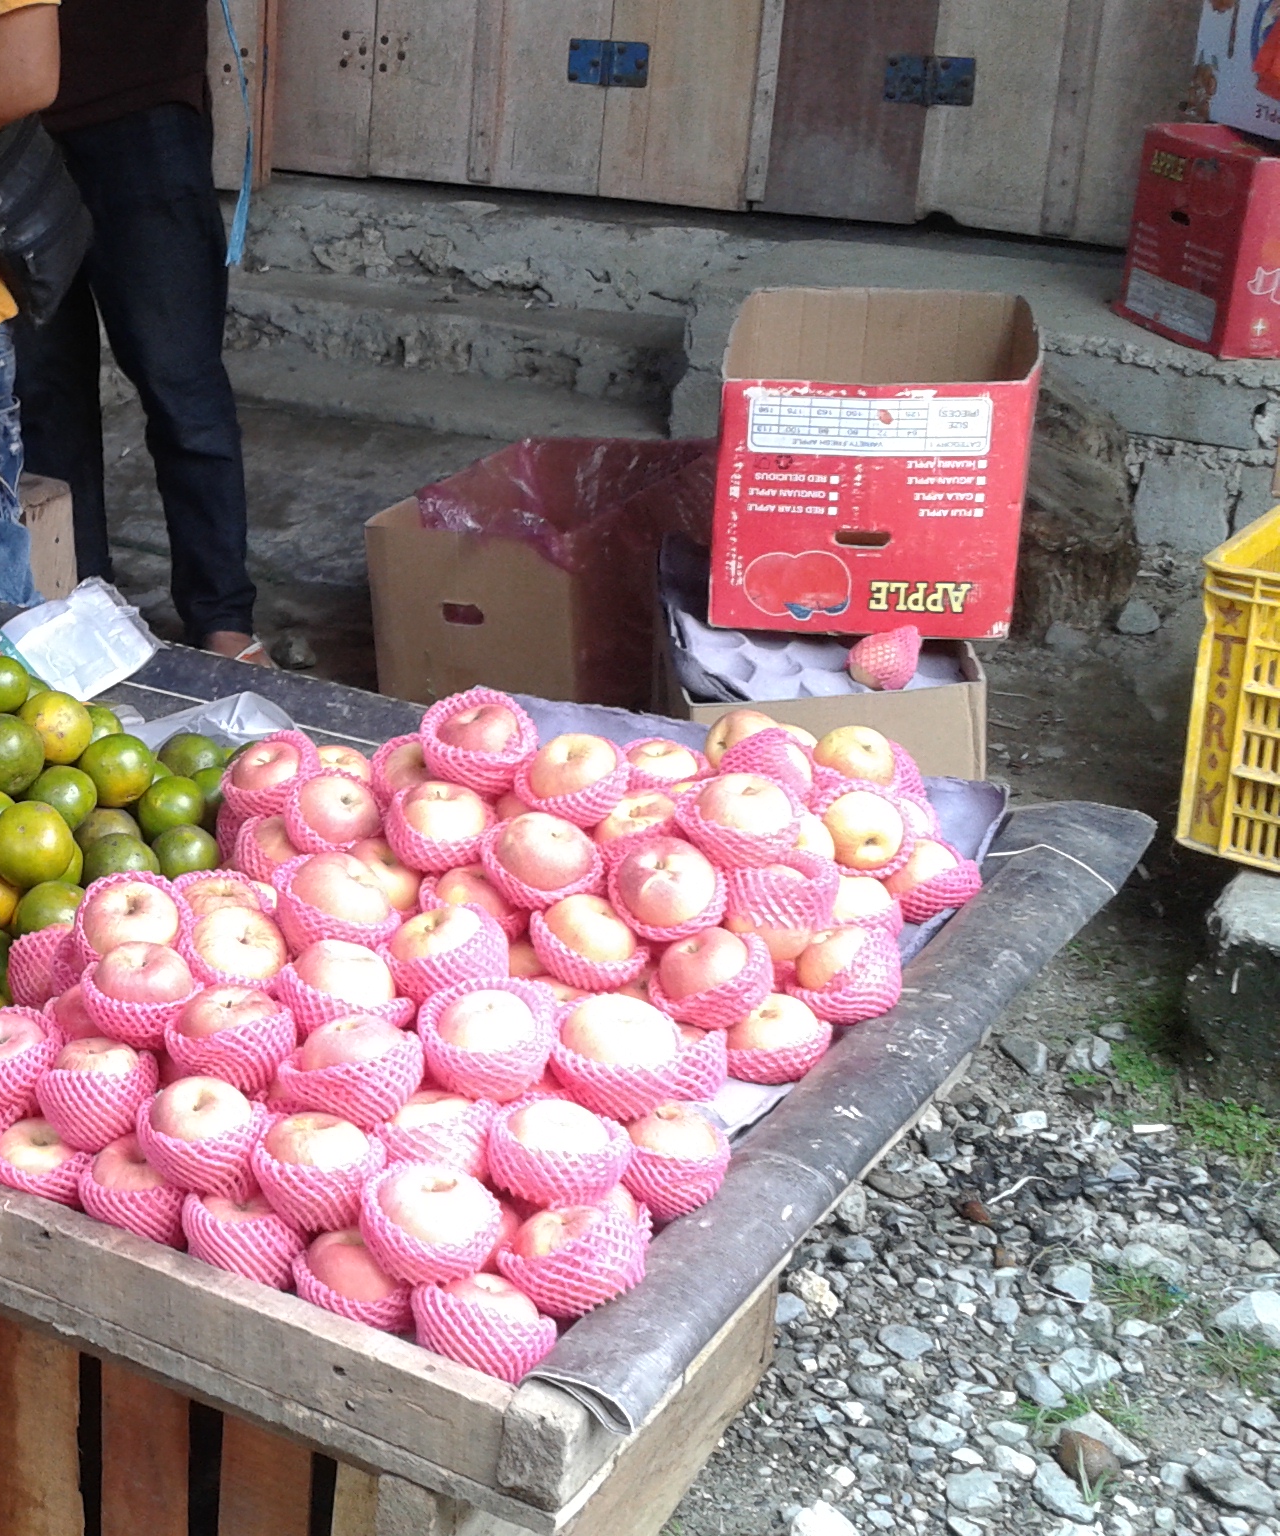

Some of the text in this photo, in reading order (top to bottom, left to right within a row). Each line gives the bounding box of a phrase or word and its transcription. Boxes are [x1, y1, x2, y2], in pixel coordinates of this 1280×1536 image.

[938, 407, 980, 418] (PIECES)
[948, 421, 969, 429] SIZE
[906, 460, 936, 469] APPLE
[754, 472, 827, 483] RED DELICIOUS
[906, 476, 937, 485] APPLE
[748, 487, 777, 497] APPLE
[913, 492, 974, 501] GALA APPLE
[746, 503, 825, 515] RED STAR APPLE
[918, 508, 973, 517] FUJI APPLE
[868, 580, 972, 614] APPLE
